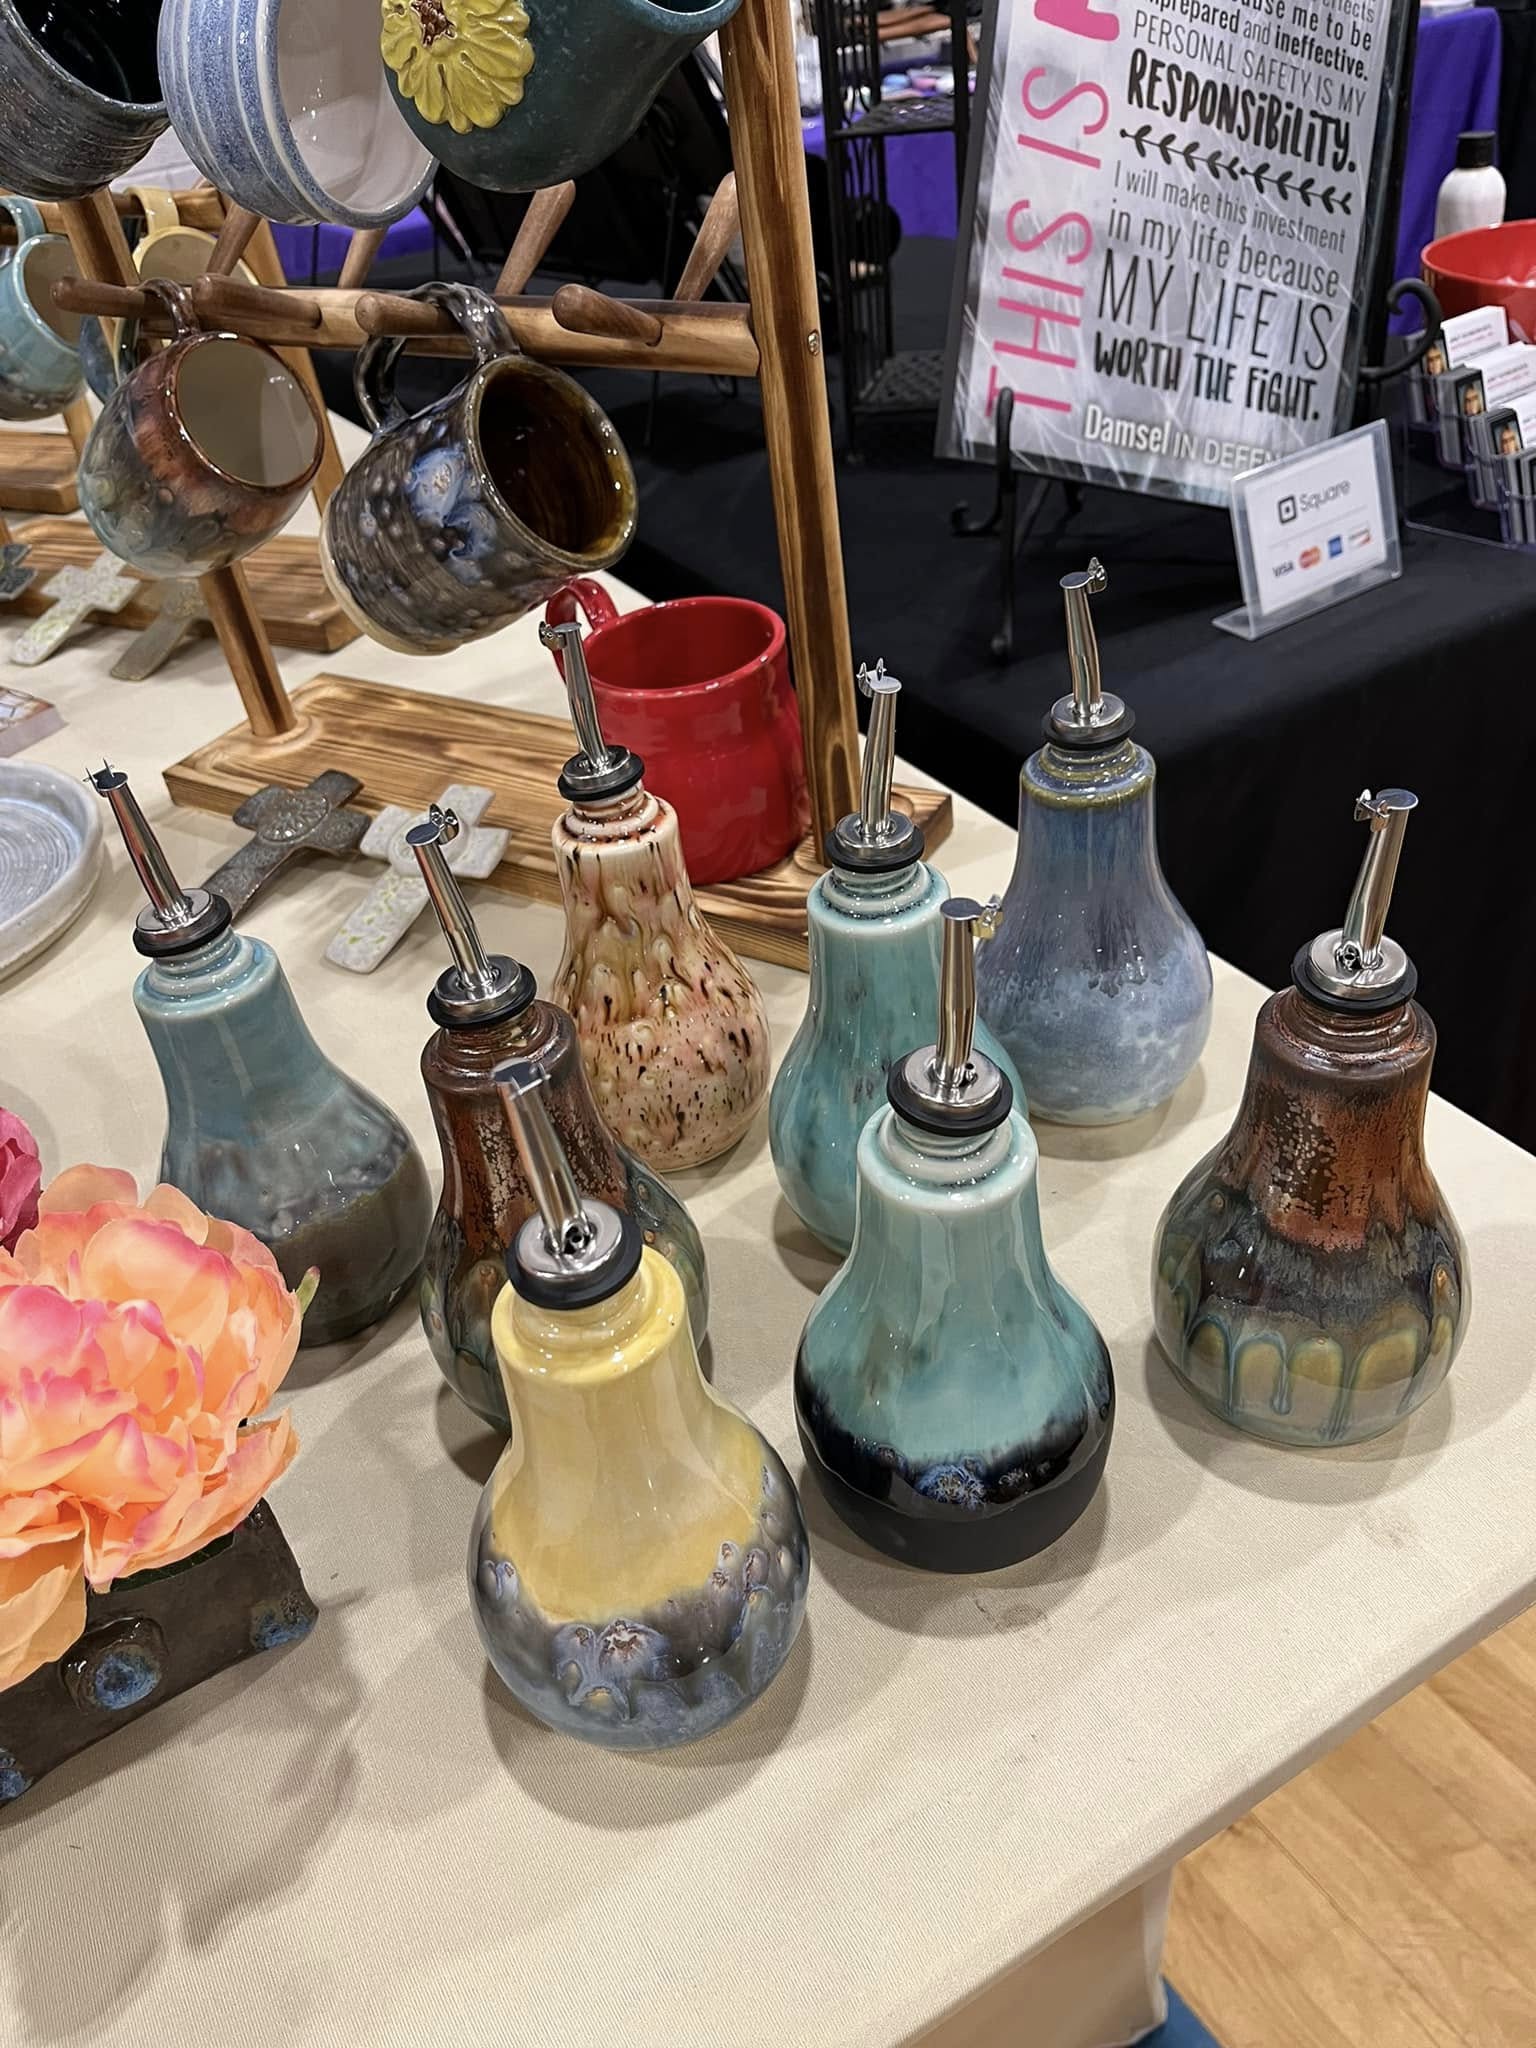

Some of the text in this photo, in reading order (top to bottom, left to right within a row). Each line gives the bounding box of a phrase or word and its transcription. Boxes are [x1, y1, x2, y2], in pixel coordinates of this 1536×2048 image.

[1134, 9, 1235, 73] PERSONAL
[1242, 49, 1312, 98] SAFETY
[1315, 75, 1333, 106] IS
[1339, 83, 1367, 116] MY
[1150, 0, 1240, 33] prepared
[1243, 20, 1271, 45] and
[1275, 25, 1368, 81] ineffective.
[1233, 0, 1372, 51] use me to be
[1017, 67, 1109, 169] IS
[1108, 199, 1340, 298] in my life because
[1113, 160, 1346, 254] I will make this investment
[985, 200, 1093, 418] THIS
[1098, 247, 1334, 371] MY LIFE IS
[1094, 331, 1184, 392] WORTH
[1193, 353, 1238, 404] THE
[1084, 403, 1281, 470] Damsel IN DEFE
[1300, 480, 1351, 512] Square
[1272, 561, 1295, 577] VISA
